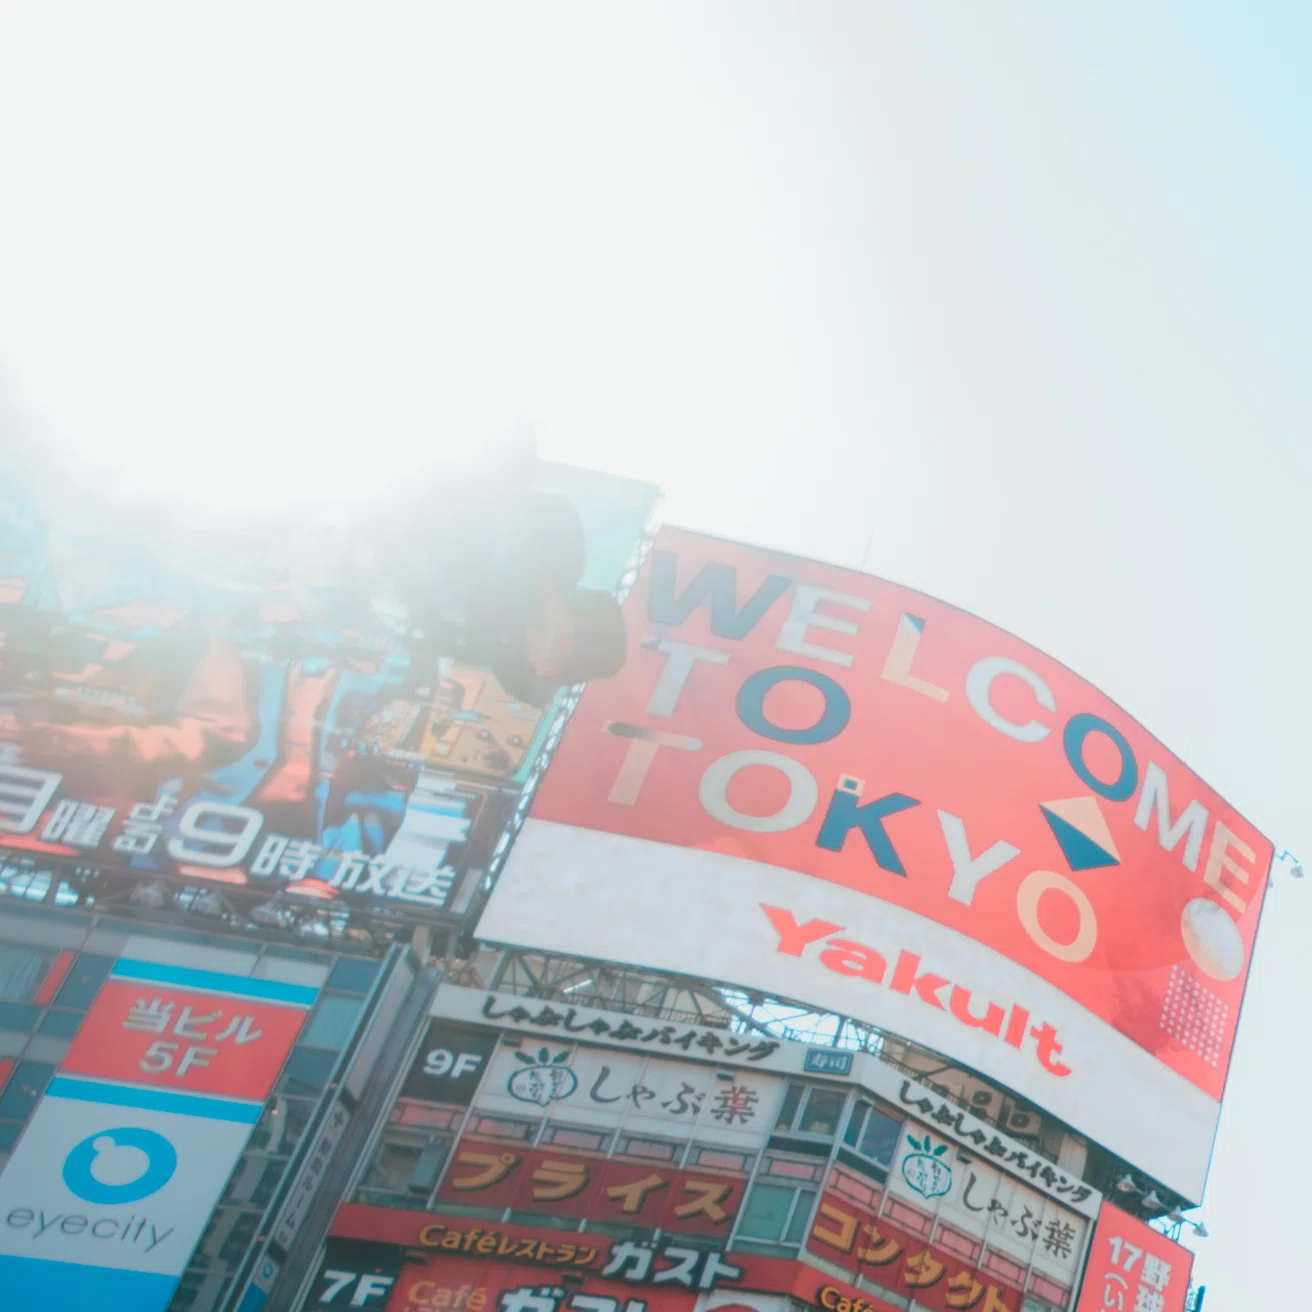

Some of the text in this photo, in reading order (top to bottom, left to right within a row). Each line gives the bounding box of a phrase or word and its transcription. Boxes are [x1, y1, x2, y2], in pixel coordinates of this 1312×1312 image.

[640, 636, 851, 745] TO
[647, 550, 1255, 912] WELCOME
[605, 722, 1097, 963] TOKYO
[759, 902, 1073, 1076] Yakult
[122, 997, 263, 1047] 当ビル
[482, 996, 780, 1060] しゃぶしゃぶバイキング
[138, 1042, 218, 1079] 5F
[423, 1050, 482, 1079] 9F
[808, 1052, 848, 1073] 寿司
[589, 1067, 758, 1124] しゃぶ葉
[900, 1080, 1092, 1203] しゃぶしゃぶバイキング
[452, 1151, 734, 1222] プライス
[5, 1206, 175, 1253] eyecity
[961, 1172, 1077, 1259] しゃぶ葉
[320, 1271, 393, 1306] 7F
[603, 1240, 742, 1290] ガスト
[407, 1280, 487, 1311] Café
